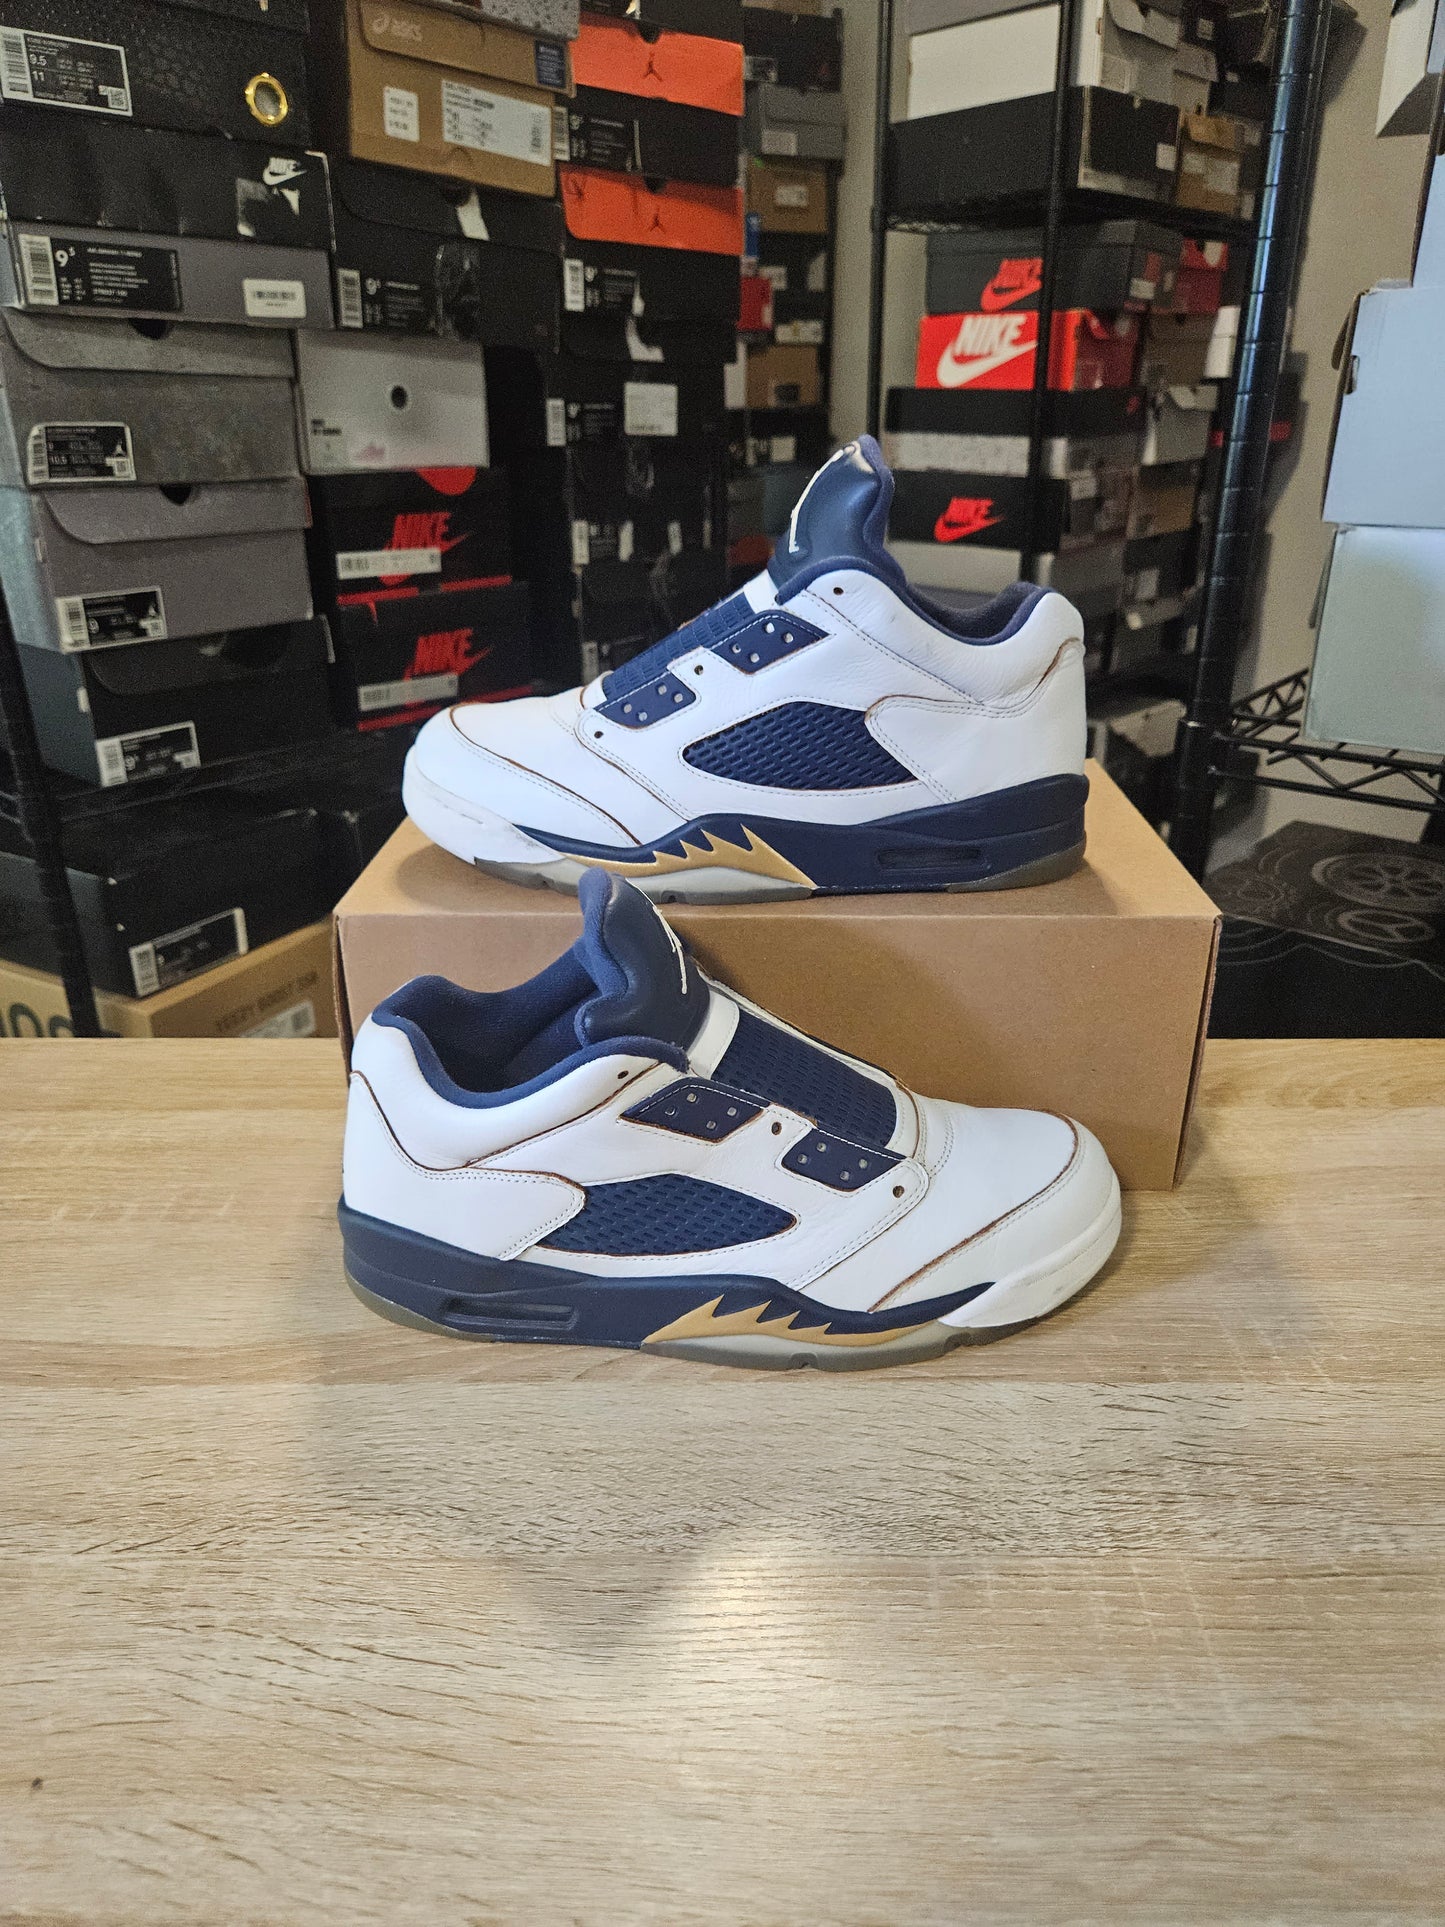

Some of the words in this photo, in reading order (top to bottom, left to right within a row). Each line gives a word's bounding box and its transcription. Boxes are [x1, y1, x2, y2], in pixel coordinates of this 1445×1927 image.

[953, 313, 1026, 356] NIKE
[392, 511, 451, 550] NIKE
[944, 497, 993, 523] NIKE
[414, 629, 473, 675] NIKE
